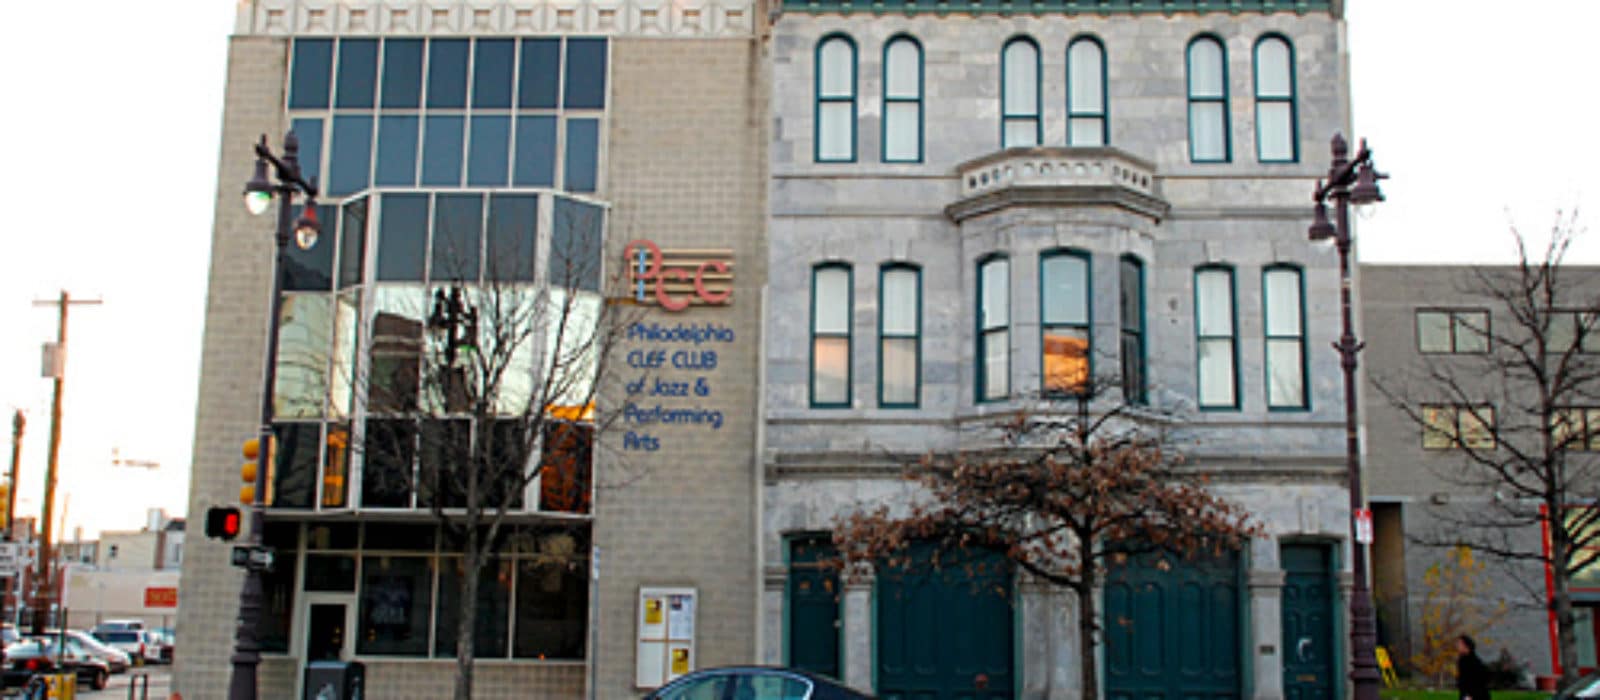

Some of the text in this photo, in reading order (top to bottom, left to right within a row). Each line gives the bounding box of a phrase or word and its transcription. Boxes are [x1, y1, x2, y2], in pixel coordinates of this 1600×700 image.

[627, 322, 735, 344] Philadelphia
[626, 351, 719, 370] CLEF CLUB
[625, 376, 710, 396] of Jazz &
[624, 402, 724, 429] Performing
[623, 431, 661, 450] Arts
